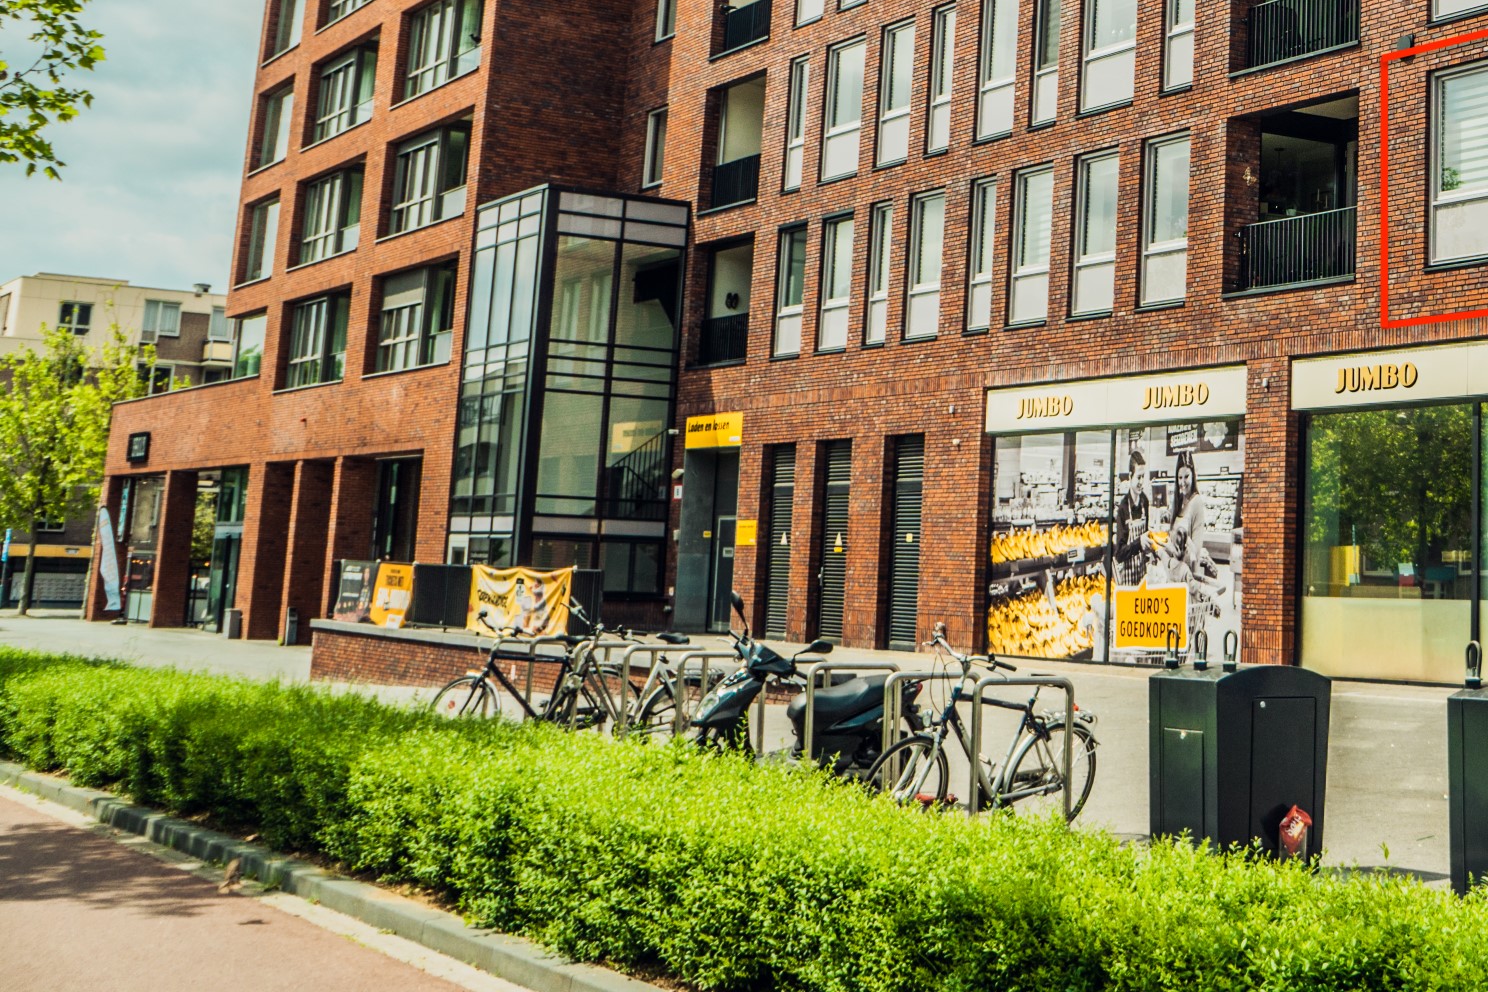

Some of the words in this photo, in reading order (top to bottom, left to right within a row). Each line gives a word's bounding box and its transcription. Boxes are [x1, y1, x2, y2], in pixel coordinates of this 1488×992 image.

[1335, 362, 1418, 393] JUMBO
[1016, 395, 1074, 419] JUMBO
[1142, 382, 1209, 409] JUMBO
[688, 421, 704, 433] Laden
[705, 423, 711, 431] en
[1134, 597, 1170, 614] EURO'S
